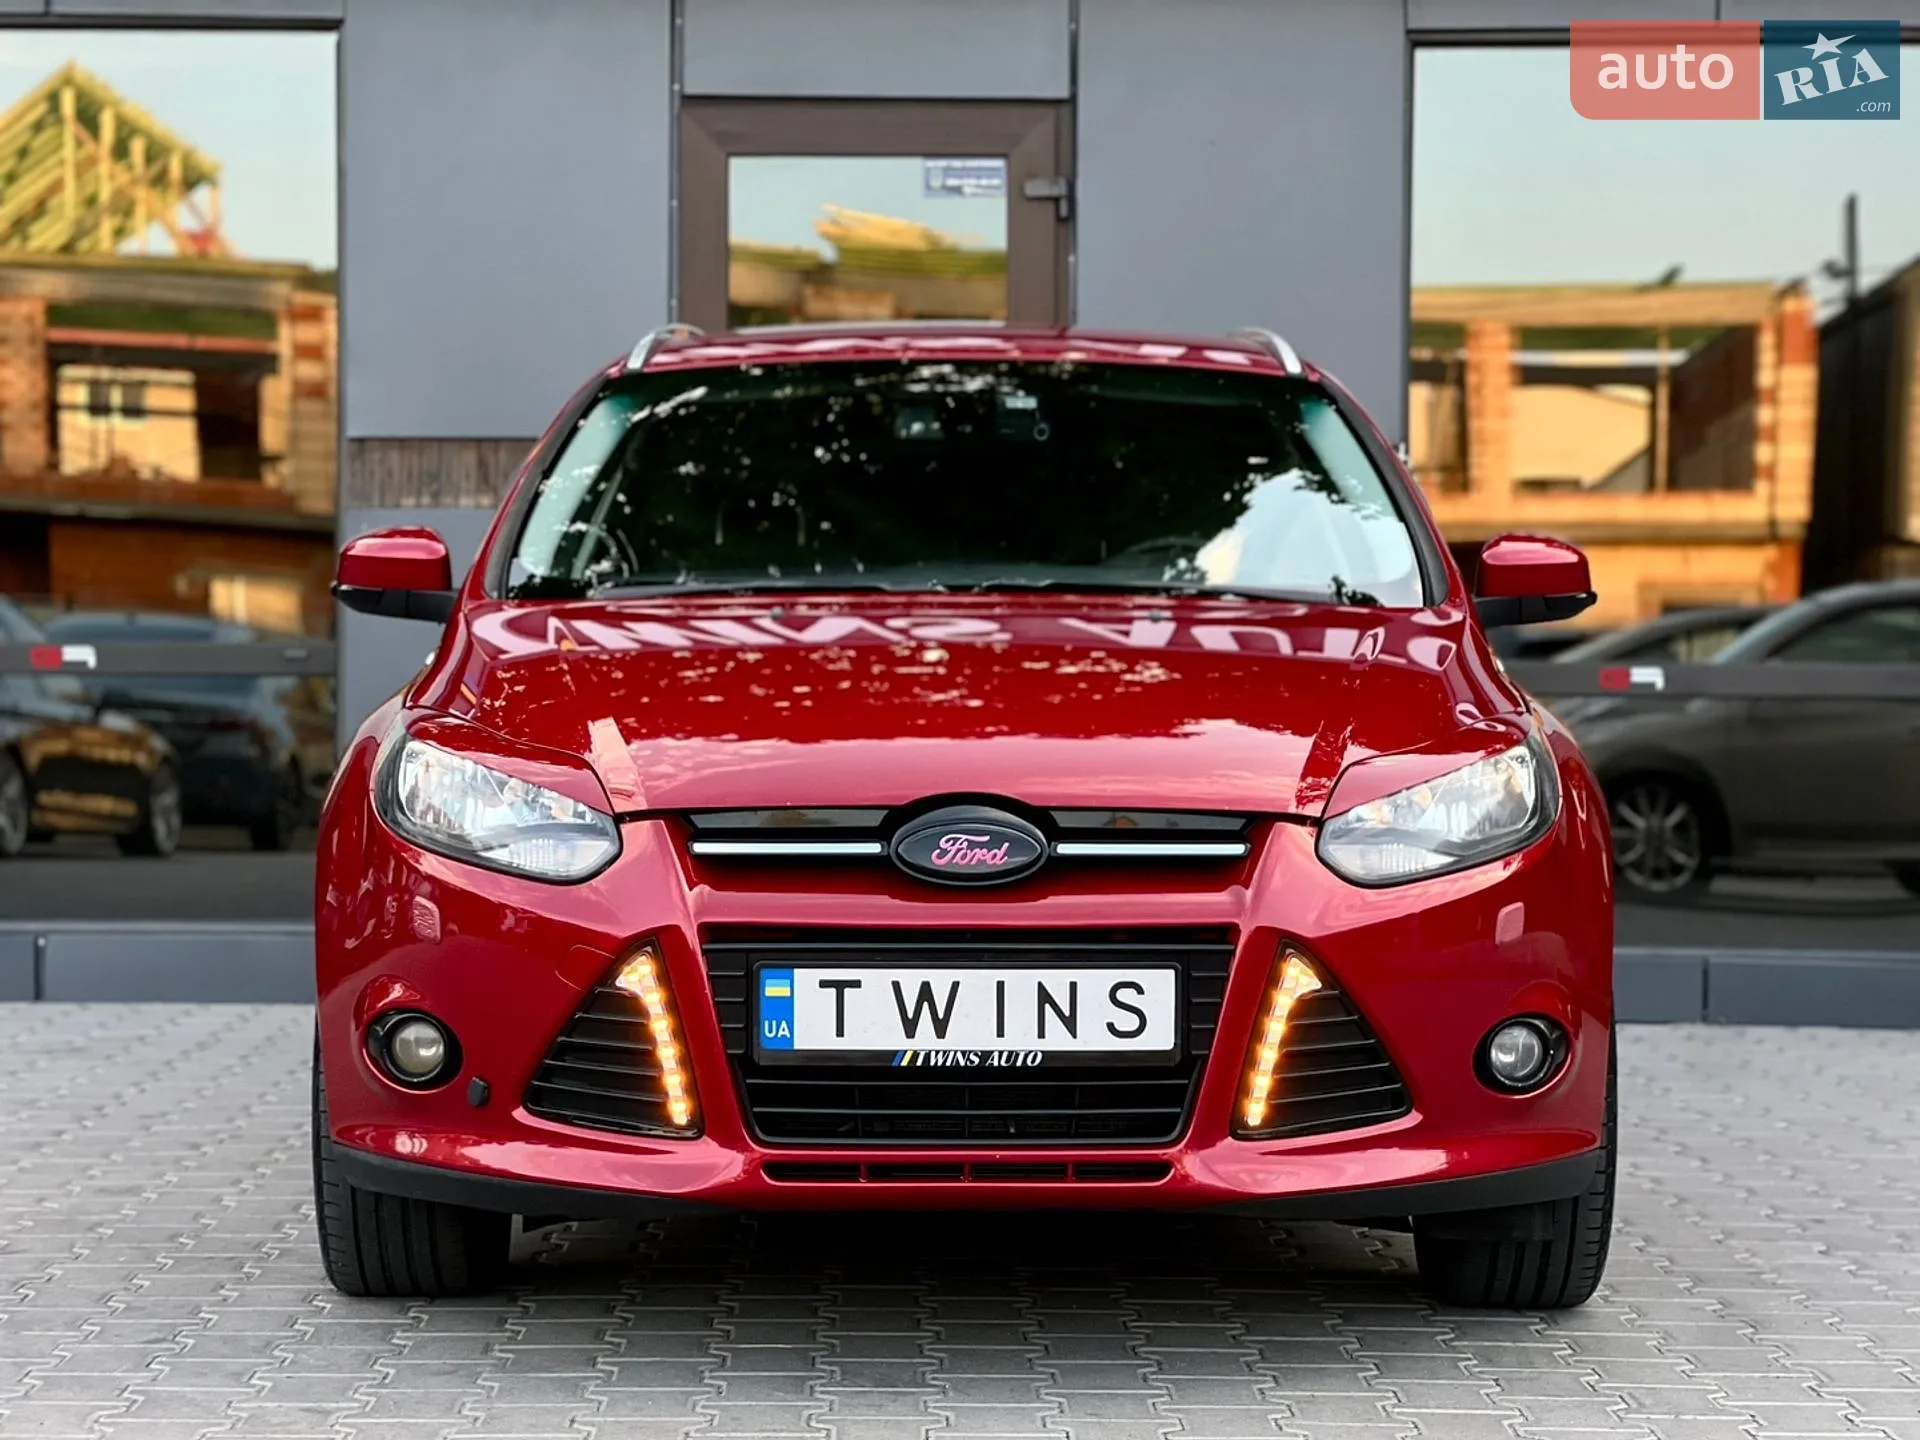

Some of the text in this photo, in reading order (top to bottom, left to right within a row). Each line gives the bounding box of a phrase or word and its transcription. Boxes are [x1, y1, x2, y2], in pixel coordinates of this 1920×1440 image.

[931, 833, 1010, 866] Ford
[818, 980, 1148, 1040] TWINS
[764, 1020, 791, 1038] UA
[916, 1050, 1043, 1067] TWINS AUTO
